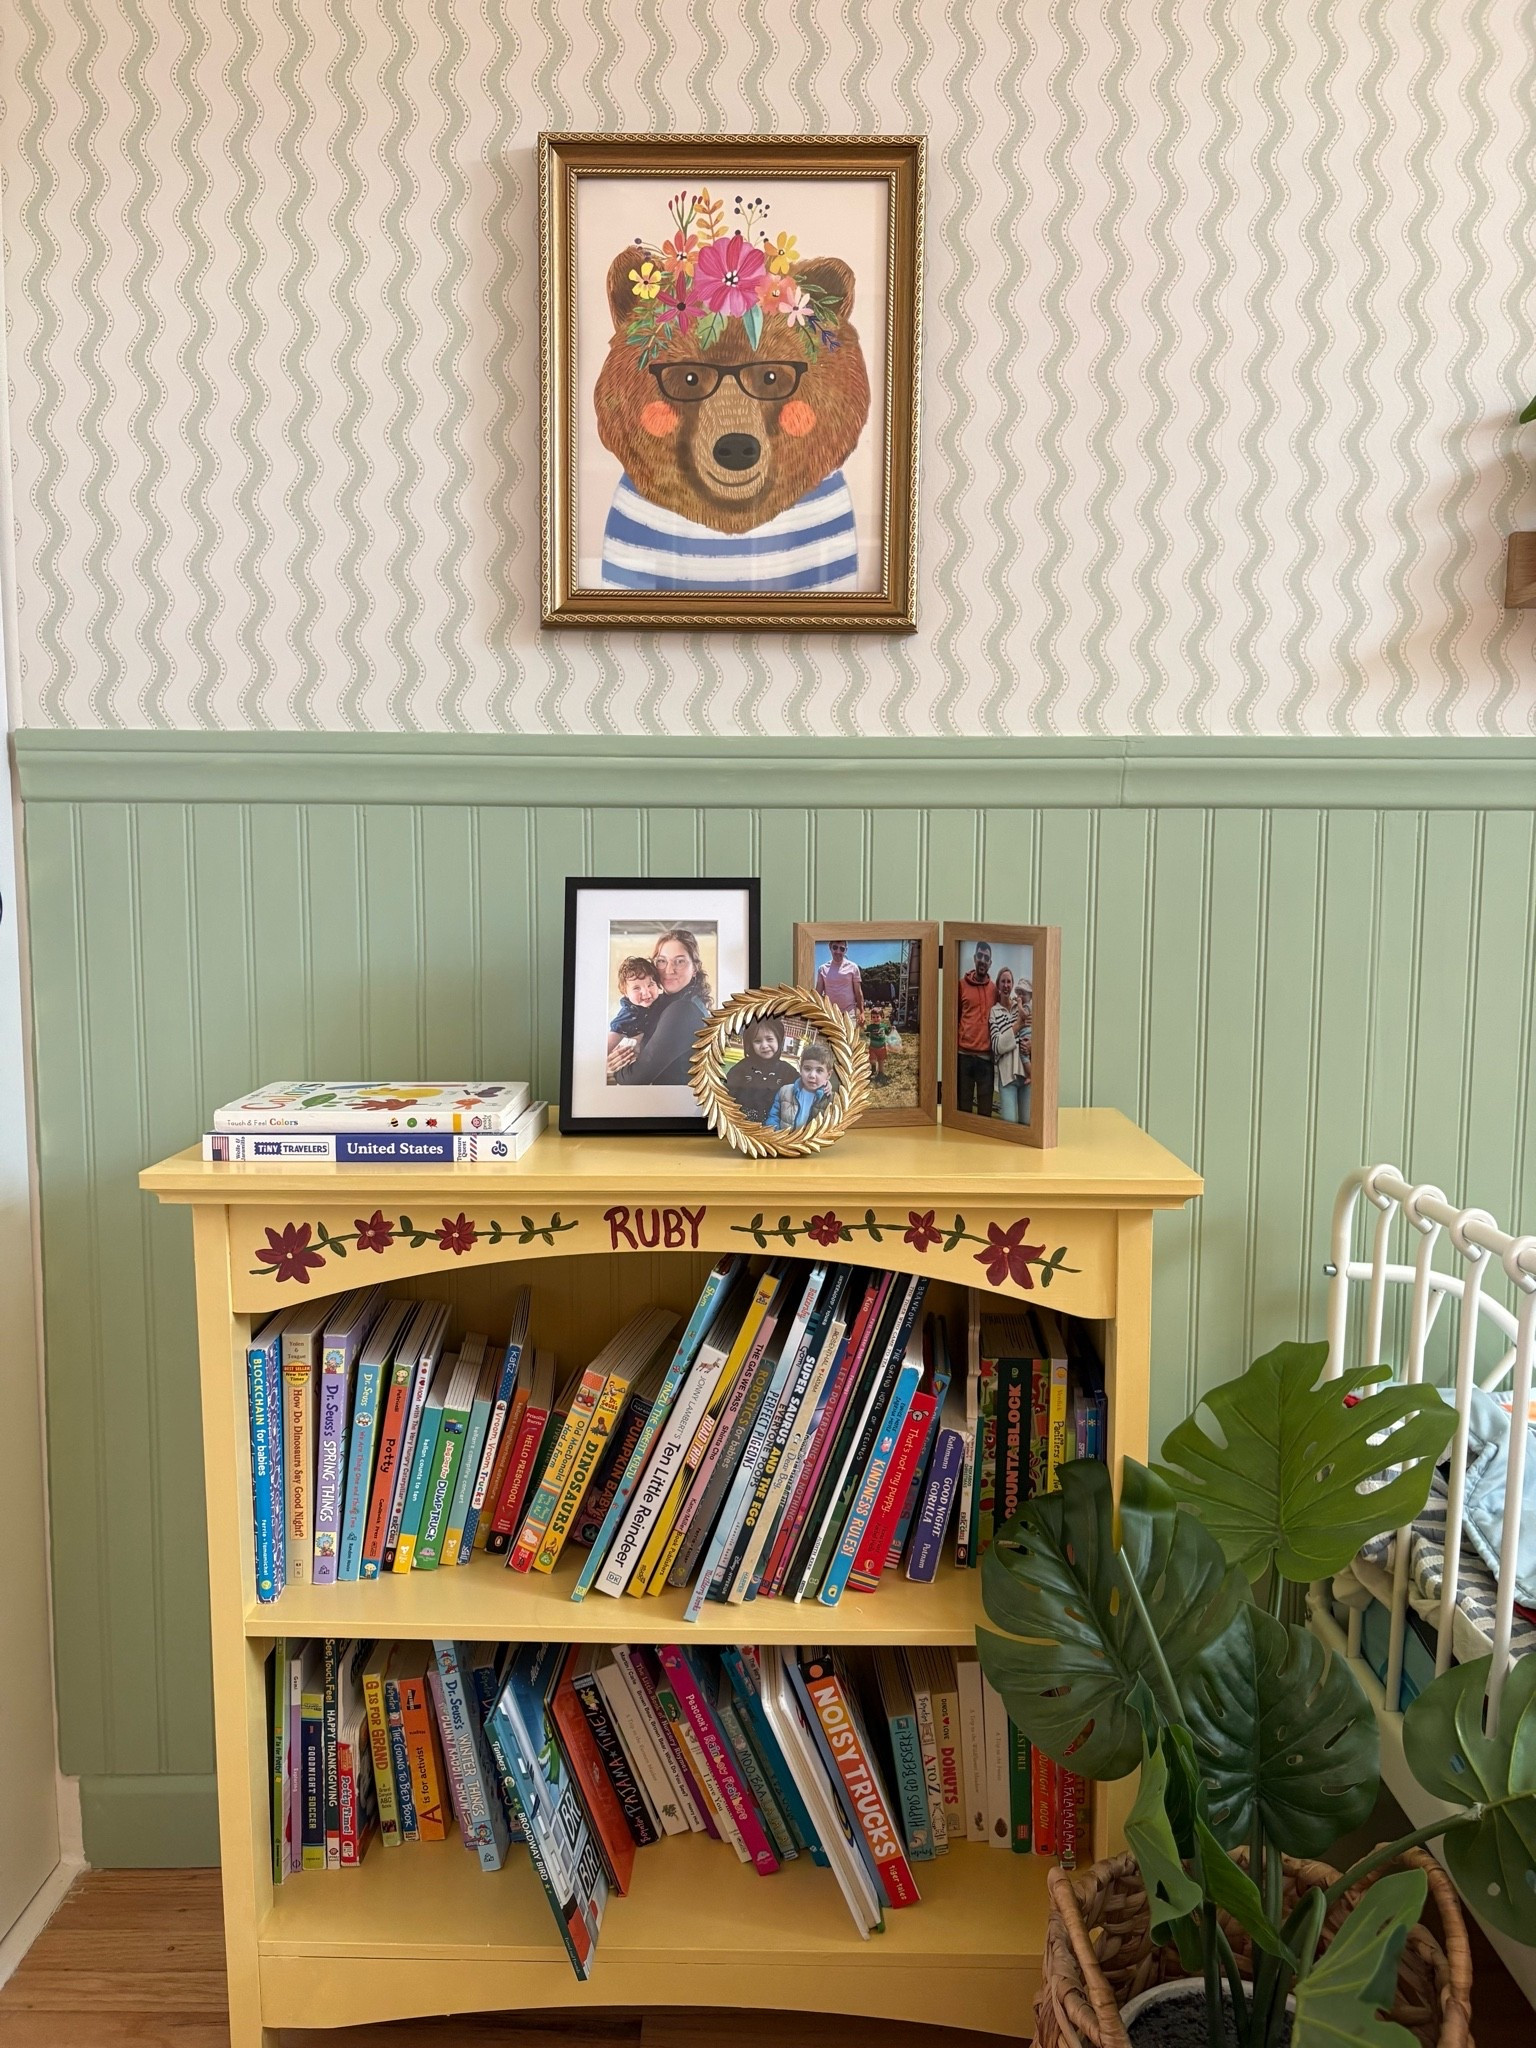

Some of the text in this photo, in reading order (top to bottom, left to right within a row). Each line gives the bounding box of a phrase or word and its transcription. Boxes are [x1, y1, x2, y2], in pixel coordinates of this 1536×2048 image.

[269, 1118, 299, 1127] Colors
[282, 1144, 328, 1153] TRAVELERS
[346, 1142, 443, 1155] United States
[603, 1205, 706, 1250] RUBY
[861, 1296, 873, 1312] Kuo
[360, 1373, 372, 1406] Dr. Seuss
[729, 1342, 764, 1412] THE GAS WE PASS
[793, 1354, 815, 1394] SUPER
[833, 1366, 848, 1391] LET'S
[600, 1399, 618, 1411] Seuss
[608, 1396, 619, 1406] Dr.
[656, 1380, 674, 1407] ANZU
[673, 1375, 706, 1439] JONNY LAMBERT'S
[828, 1391, 838, 1404] DO
[253, 1358, 266, 1475] BLOCKCHAIN for babies
[559, 1423, 572, 1440] Had
[648, 1407, 662, 1425] THE
[721, 1369, 768, 1469] ROBOTICS for babies
[740, 1390, 779, 1469] PERFECT PIGEONS
[775, 1396, 800, 1445] SAURUS
[808, 1405, 833, 1459] EVERYTHING
[320, 1384, 338, 1521] Dr. Seuss's SPRING THINGS
[520, 1433, 534, 1458] HELLO
[554, 1419, 585, 1482] Old MacDonald
[610, 1416, 644, 1479] PUMPKIN
[636, 1425, 654, 1453] GREAT
[685, 1414, 716, 1468] ROAD TRIP!
[709, 1424, 728, 1461] Shinta Cho
[749, 1402, 786, 1488] EVERYONE POOPS
[901, 1426, 919, 1454] That's
[941, 1434, 955, 1469] Rathmann
[292, 1389, 303, 1537] How Do Dinosaurs Say Good Night?
[415, 1458, 425, 1480] counts
[472, 1411, 503, 1506] Vroom, Vroom, Trucks!
[548, 1447, 562, 1469] Farm
[625, 1454, 642, 1479] KAIJU
[763, 1446, 782, 1475] AND
[800, 1460, 813, 1480] AND
[896, 1454, 909, 1470] not
[411, 1490, 419, 1501] ten
[505, 1458, 526, 1507] PRESCHOOL!
[551, 1439, 599, 1535] DINOSAURS
[754, 1474, 771, 1499] THE
[889, 1470, 902, 1485] my
[938, 1476, 953, 1504] GOOD
[612, 1439, 681, 1569] Ten Little Reindeer
[744, 1500, 761, 1527] EGG
[785, 1481, 805, 1521] NOTHING
[839, 1458, 886, 1557] KINDNESS RULES!
[922, 1480, 940, 1523] GORILLA
[658, 1497, 697, 1576] Kane/Miller Book Publishers
[917, 1543, 930, 1568] Putnam
[608, 1574, 619, 1583] DK
[618, 1651, 637, 1685] Martin Carle
[365, 1680, 389, 1770] G IS FOR GRAND
[634, 1662, 689, 1773] The Little Book of Nursery Rhymes
[326, 1709, 336, 1806] HAPPY THANKSGIVING
[445, 1680, 485, 1816] Dr. Seuss's WINTER THINGS
[491, 1740, 508, 1771] Timbers
[685, 1693, 708, 1733] Peacock's
[703, 1733, 731, 1776] Rainbow
[721, 1775, 748, 1821] Feathers
[415, 1746, 443, 1827] A is for activist
[606, 1757, 643, 1817] PAJAMA
[813, 1685, 897, 1859] NOISY TRUCKS
[896, 1729, 925, 1827] HIPPOS GO BERSERK!
[923, 1752, 941, 1795] A TO Z
[939, 1746, 960, 1804] DONUTS
[339, 1776, 351, 1806] Potty
[308, 1796, 316, 1828] SOCCER
[342, 1808, 352, 1833] Time!
[517, 1811, 548, 1881] BROADWAY BIRD
[887, 1864, 908, 1900] tiger tales
